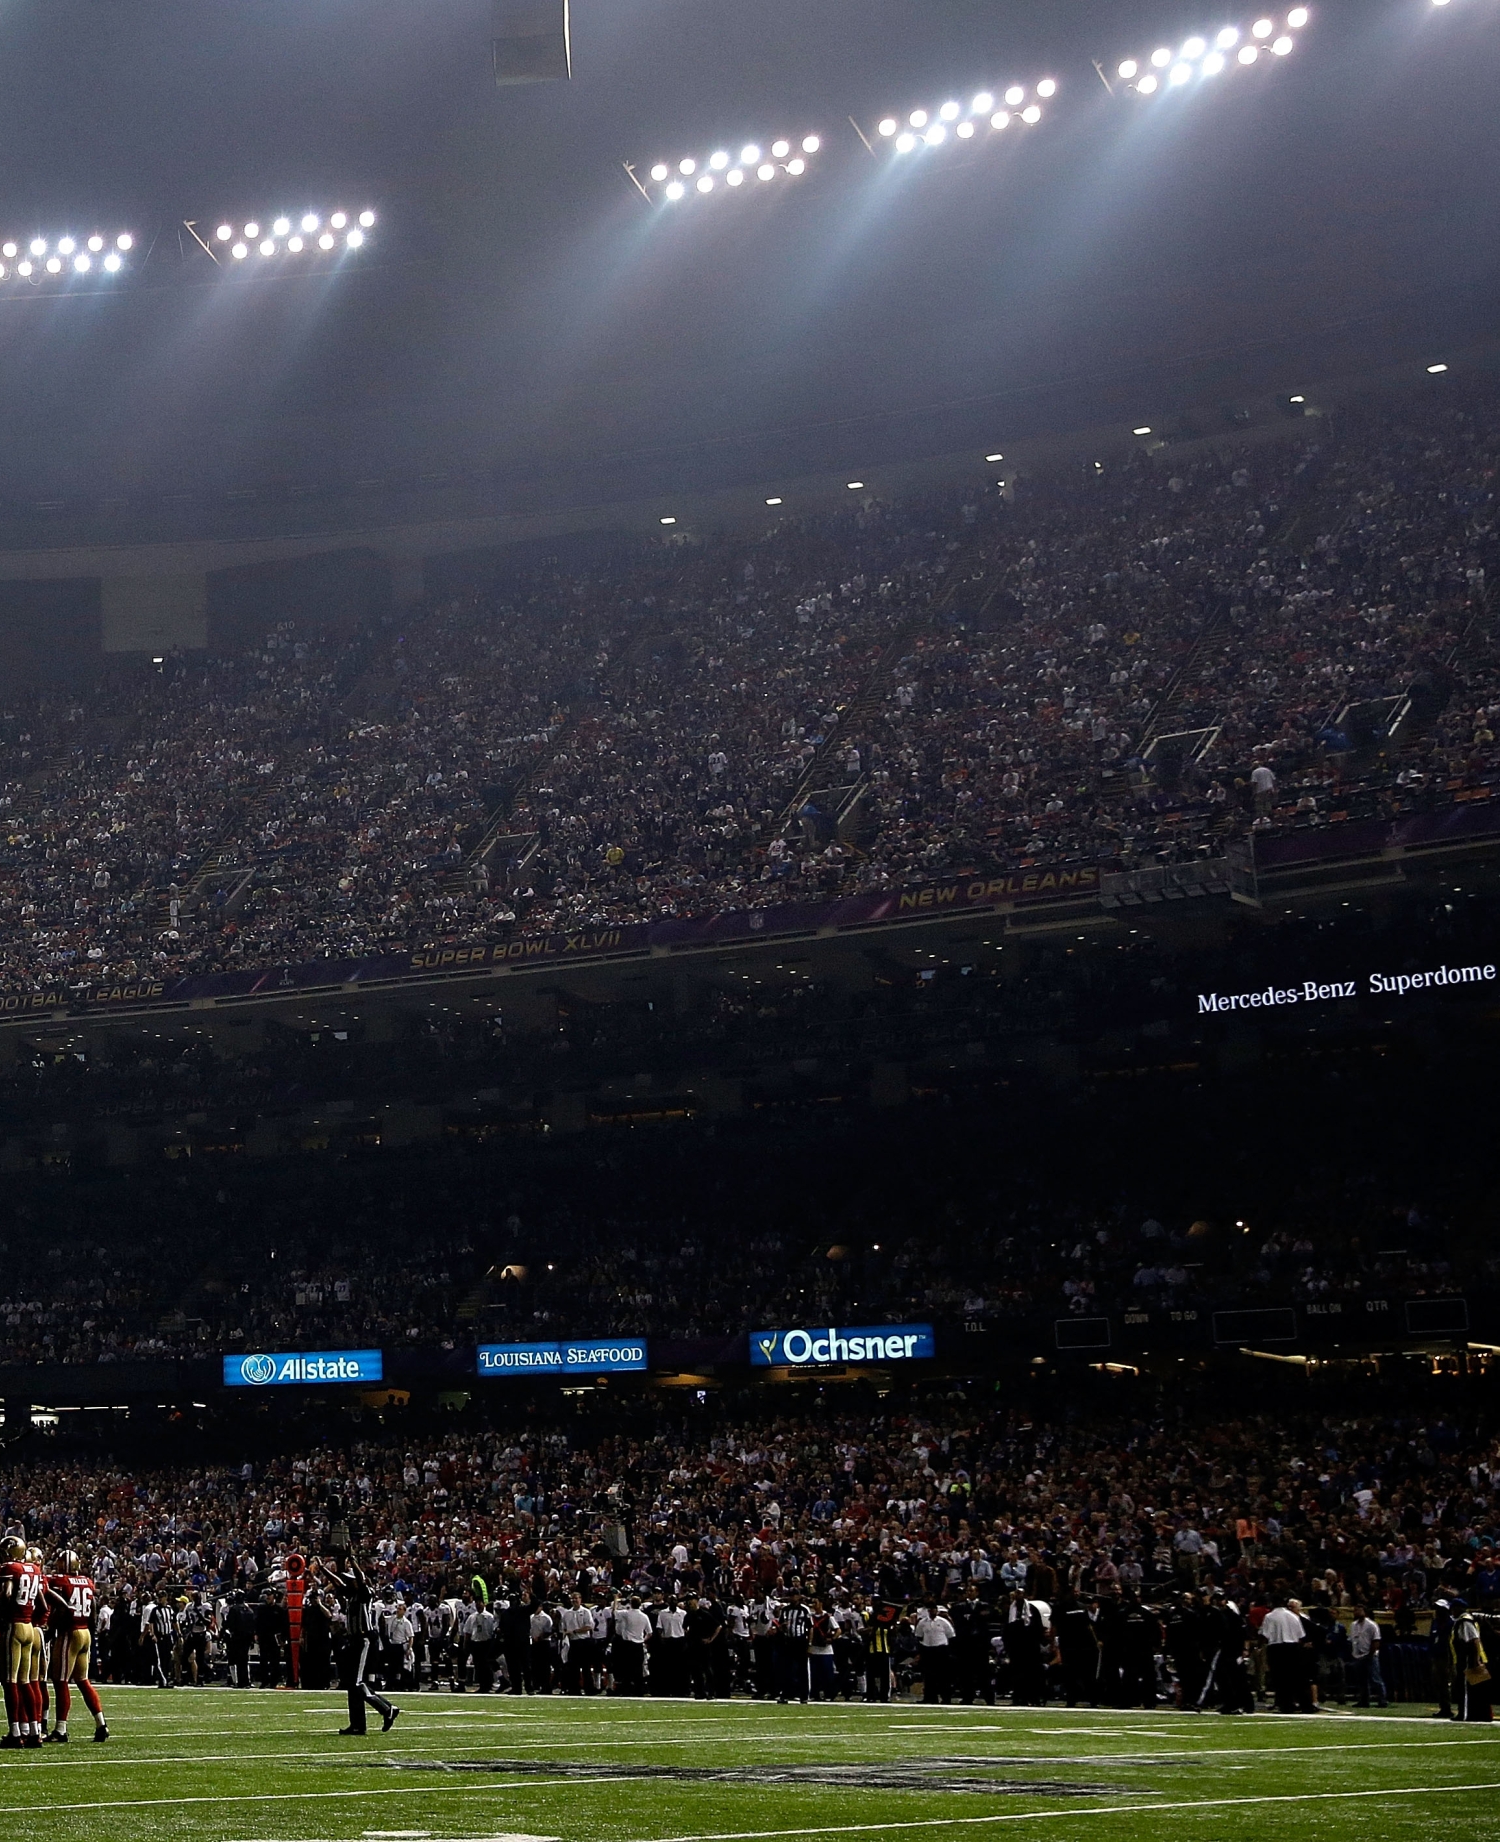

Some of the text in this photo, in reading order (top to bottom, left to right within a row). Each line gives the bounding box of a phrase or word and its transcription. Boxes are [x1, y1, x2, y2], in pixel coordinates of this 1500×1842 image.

[900, 866, 1100, 909] NEW ORLEANS
[411, 931, 621, 969] SUPER BOWL XLVII
[85, 982, 165, 1002] LEAGUE
[1197, 963, 1497, 1014] Mercedes-Benz Superdome
[1170, 1310, 1197, 1322] TO GO
[1306, 1303, 1328, 1314] BALL
[1365, 1300, 1389, 1312] QTR
[1124, 1313, 1149, 1324] DOWN
[479, 1347, 643, 1367] LOUISIANA SEAFOOD
[783, 1328, 918, 1363] Ochsner
[278, 1357, 359, 1380] Allstate
[16, 1573, 39, 1606] 84
[69, 1587, 93, 1617] 46
